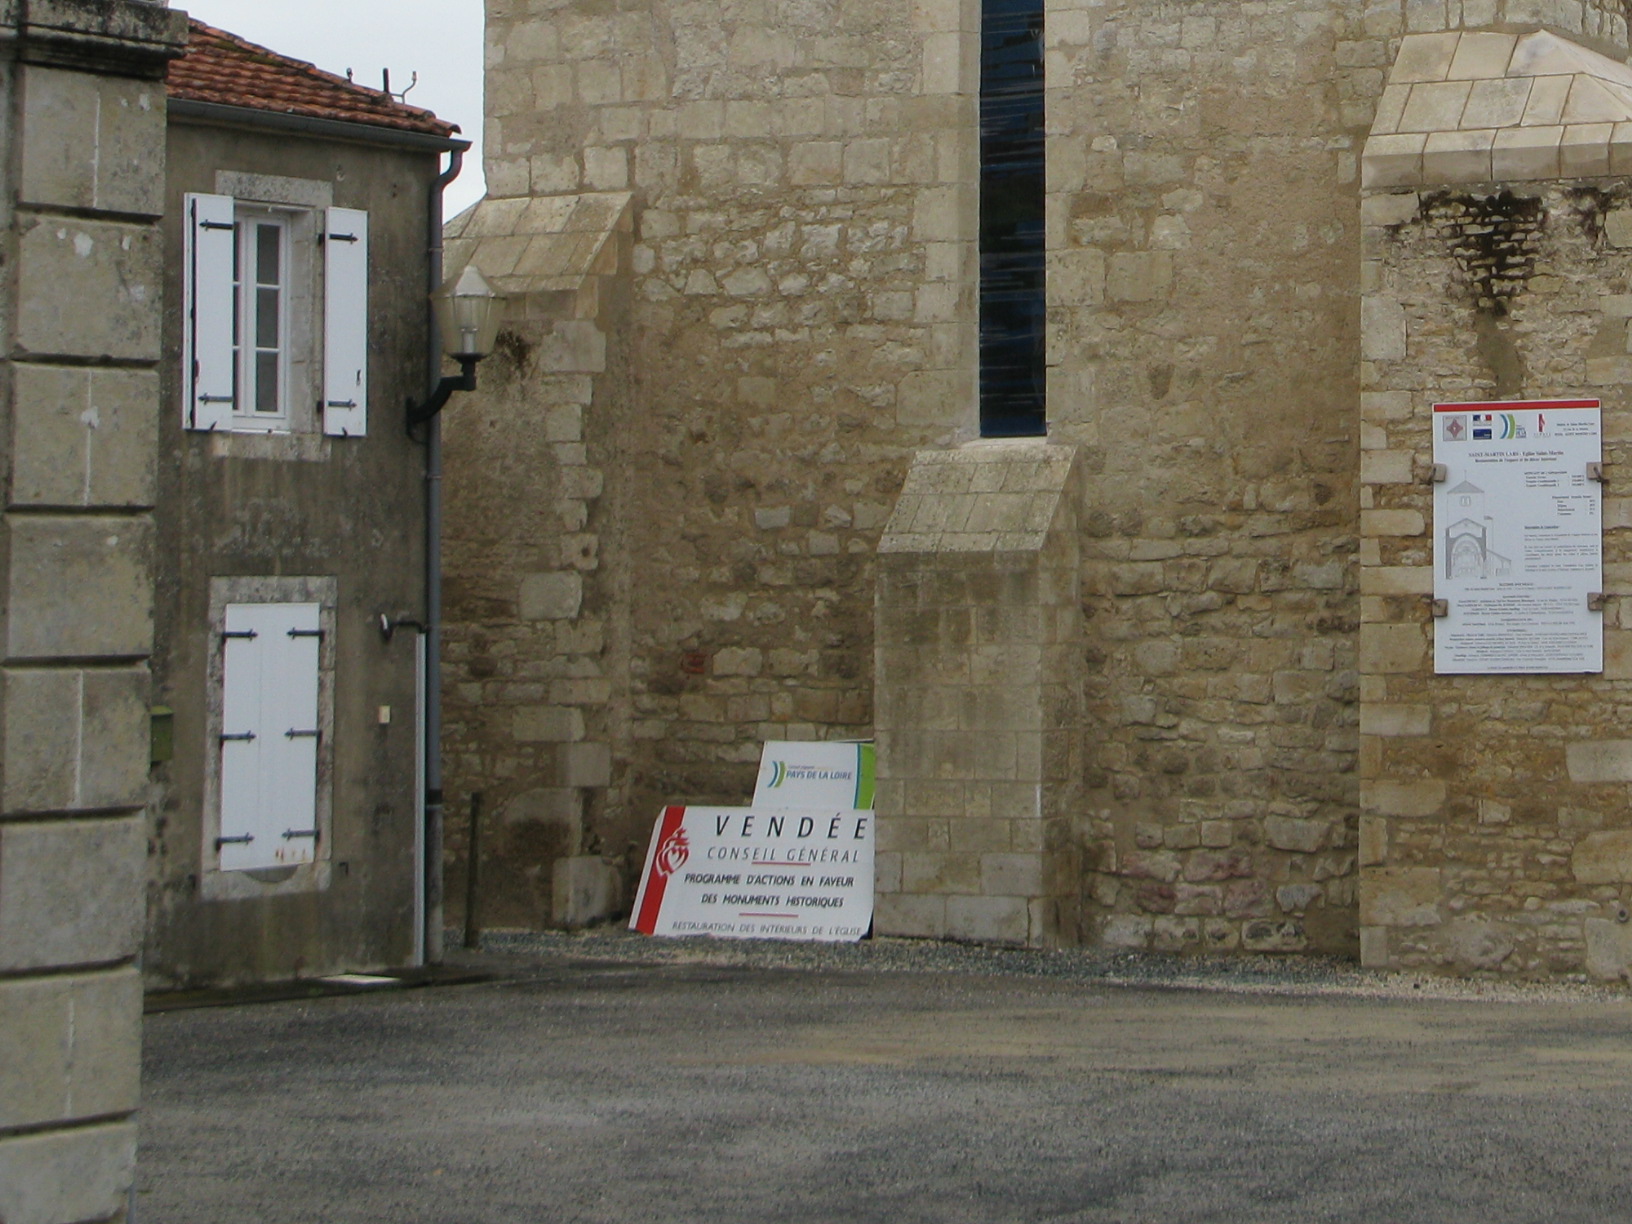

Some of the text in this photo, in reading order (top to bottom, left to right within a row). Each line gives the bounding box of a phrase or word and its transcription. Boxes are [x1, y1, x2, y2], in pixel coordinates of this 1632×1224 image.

[786, 770, 852, 780] PAYS DE LA LOIRE
[715, 812, 868, 840] VENDÉE
[707, 846, 860, 863] CONSEIL GÉNÉRAL
[684, 873, 741, 885] PROGRAMME
[746, 874, 796, 886] D'ACTIONS
[801, 876, 814, 886] EN
[701, 894, 844, 908] DES MONUMENTS HISTORIQUES
[672, 921, 735, 932] RESTAURATION
[739, 922, 755, 932] DES
[812, 925, 824, 935] DE
[829, 924, 862, 936] L'ÉGLISE
